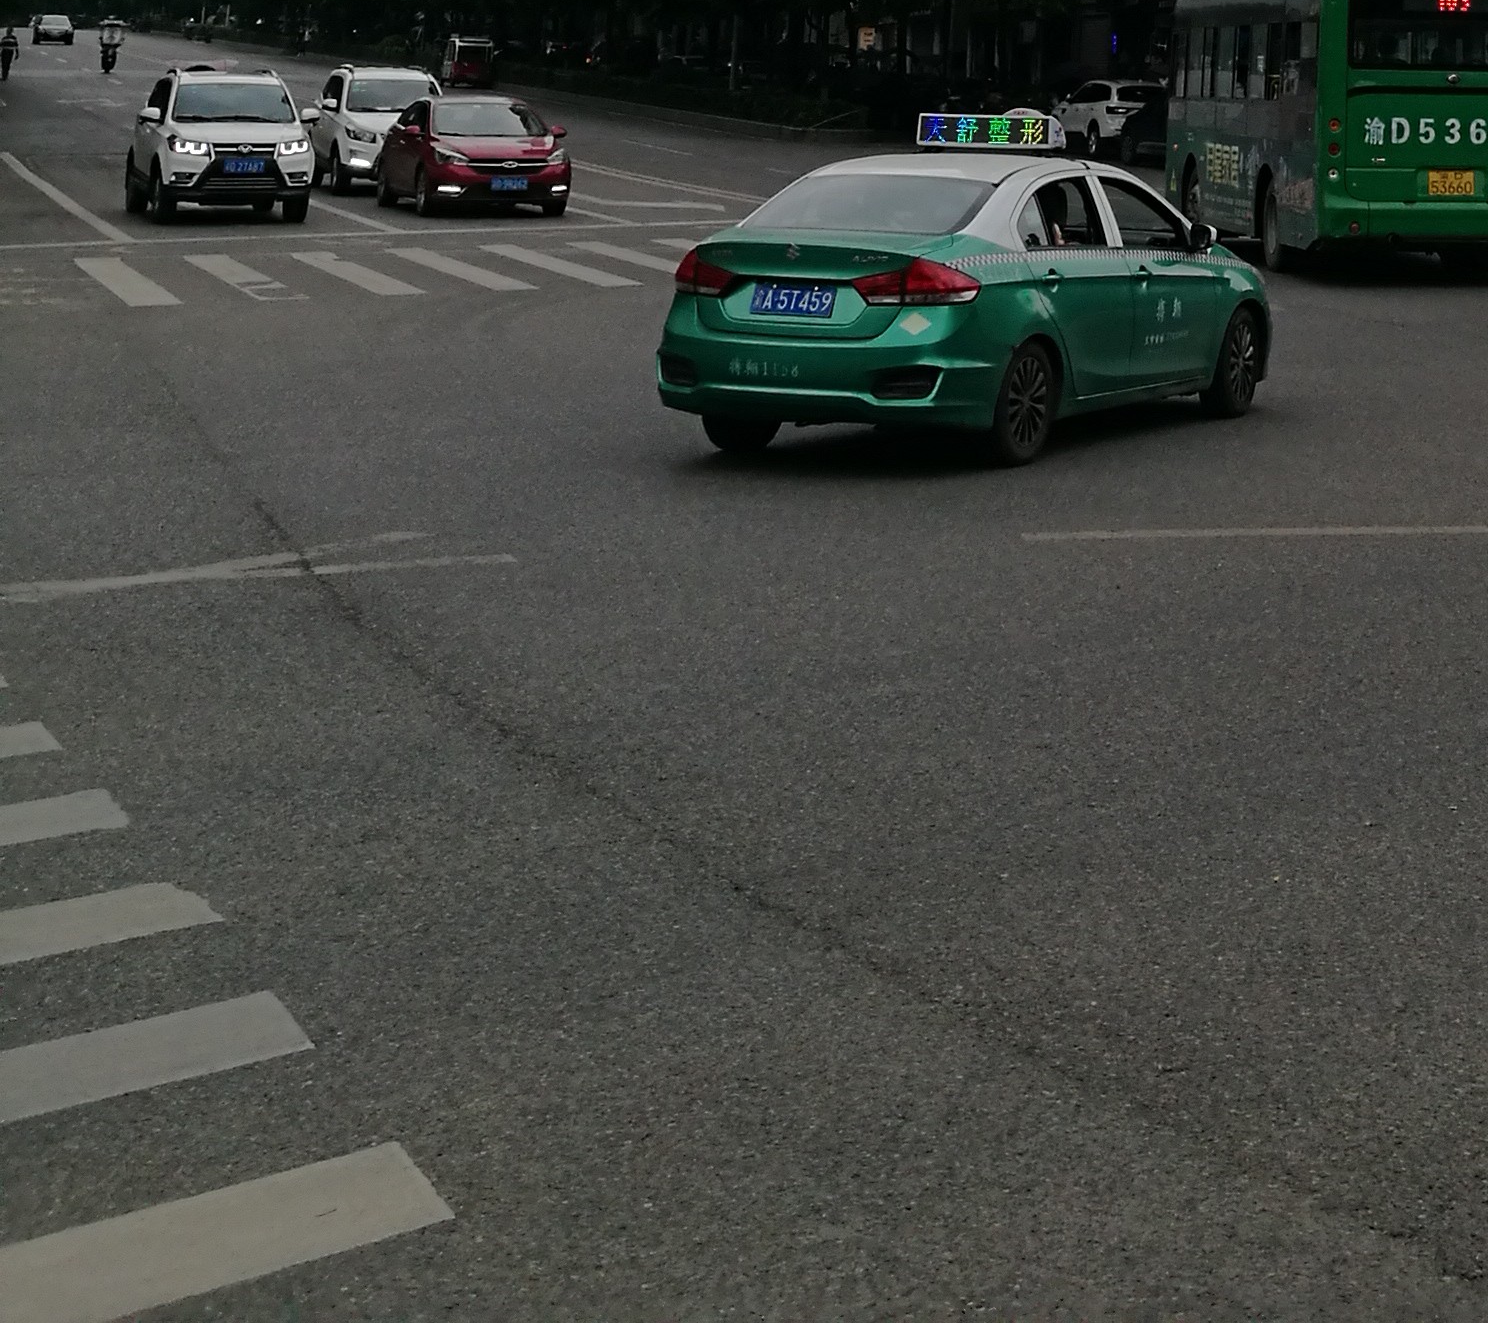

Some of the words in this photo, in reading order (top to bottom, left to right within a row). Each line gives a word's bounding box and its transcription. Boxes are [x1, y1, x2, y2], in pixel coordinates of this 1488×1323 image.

[924, 117, 1044, 145] 天舒整形
[1430, 180, 1473, 194] 53660
